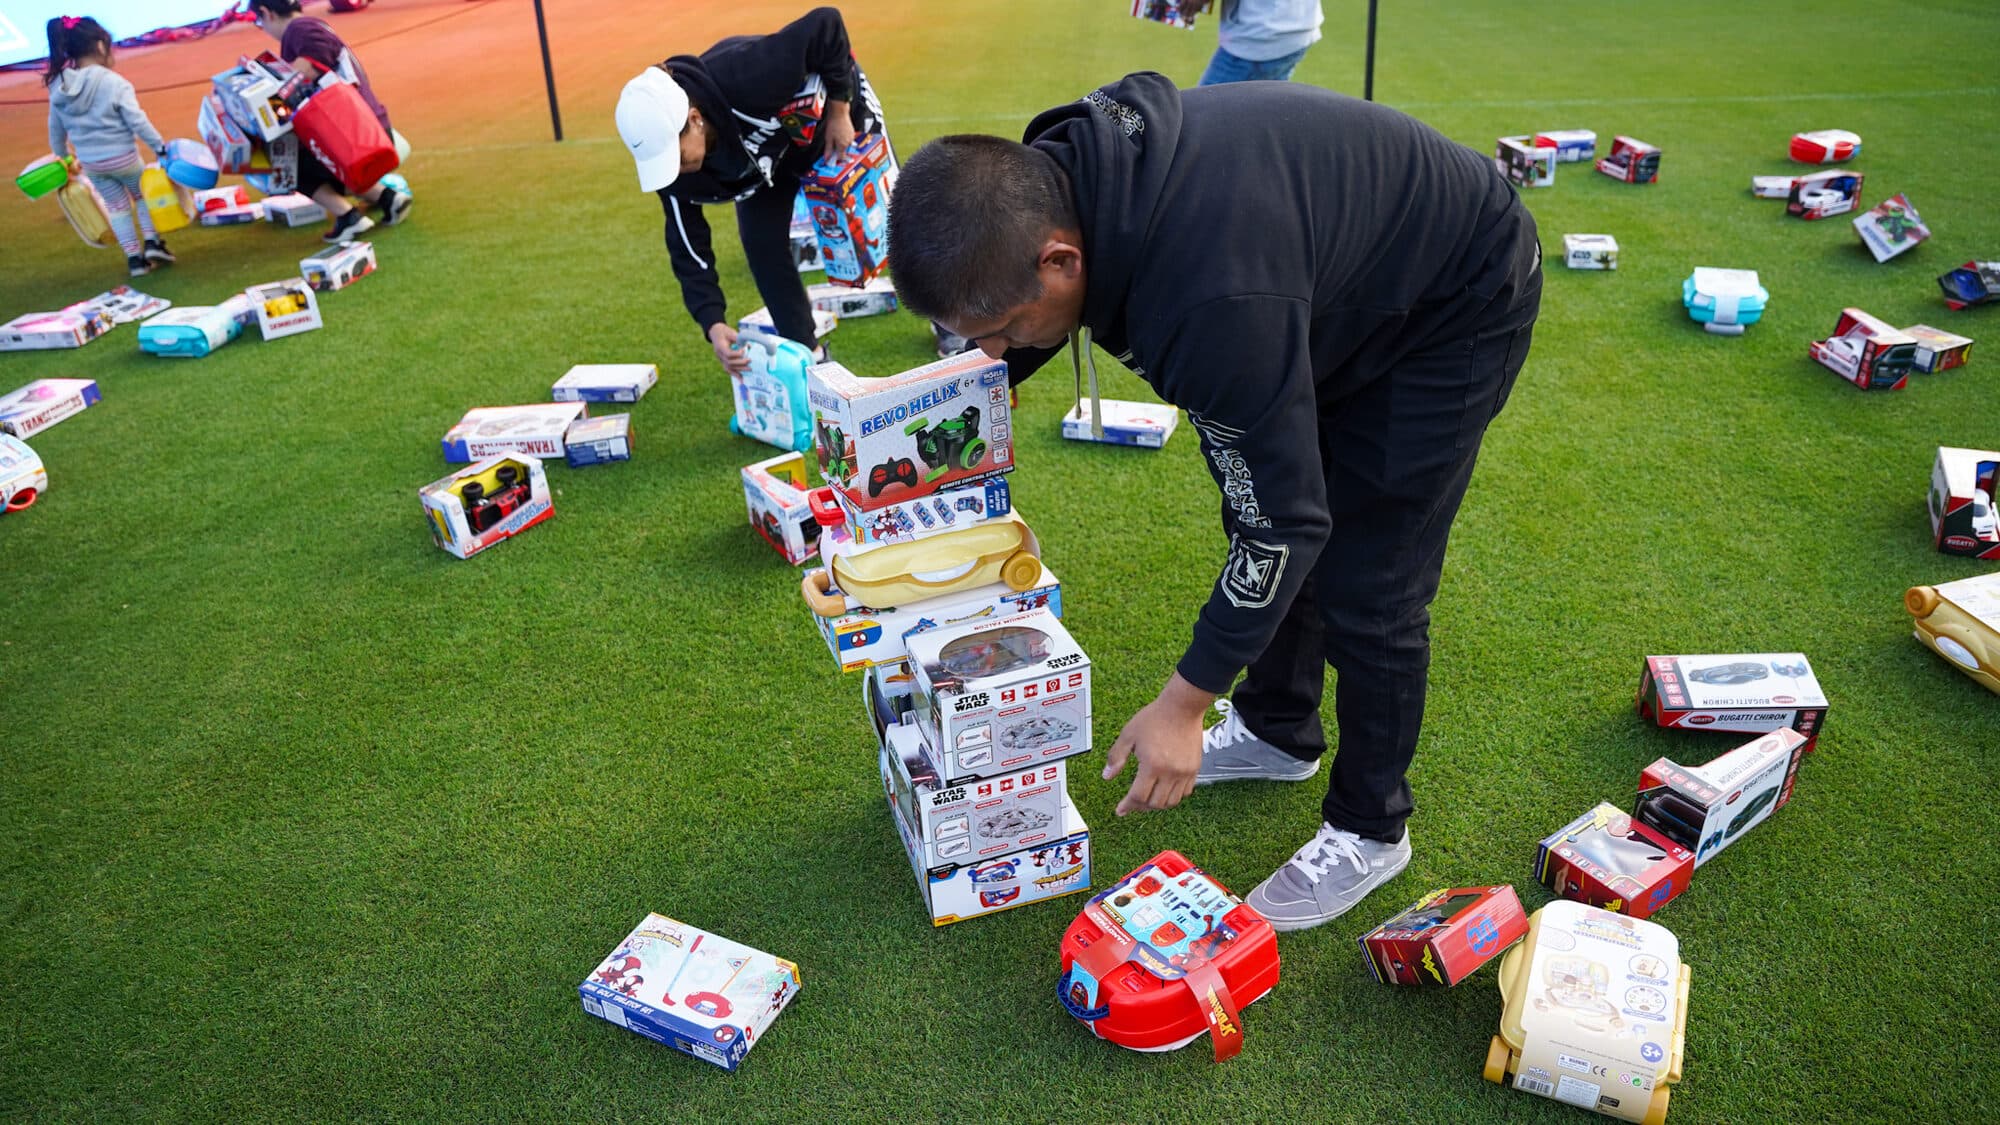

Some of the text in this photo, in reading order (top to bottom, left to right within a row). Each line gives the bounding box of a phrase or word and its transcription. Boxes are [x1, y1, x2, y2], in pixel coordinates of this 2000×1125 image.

[860, 378, 961, 438] REVO HELIX
[962, 474, 985, 485] CONTROL
[1947, 538, 1975, 548] BUGATTI
[1047, 652, 1082, 666] WARS
[1051, 658, 1081, 670] STAR
[954, 692, 990, 706] STAR
[954, 700, 989, 713] WARS
[1718, 714, 1754, 722] BUGATTI
[1754, 713, 1788, 721] CHIRON
[932, 787, 967, 801] STAR
[932, 794, 967, 806] WARS
[1092, 912, 1128, 946] HANDYMAN
[1468, 918, 1498, 950] DC
[1642, 1045, 1662, 1058] 3+
[1592, 1065, 1607, 1078] CE
